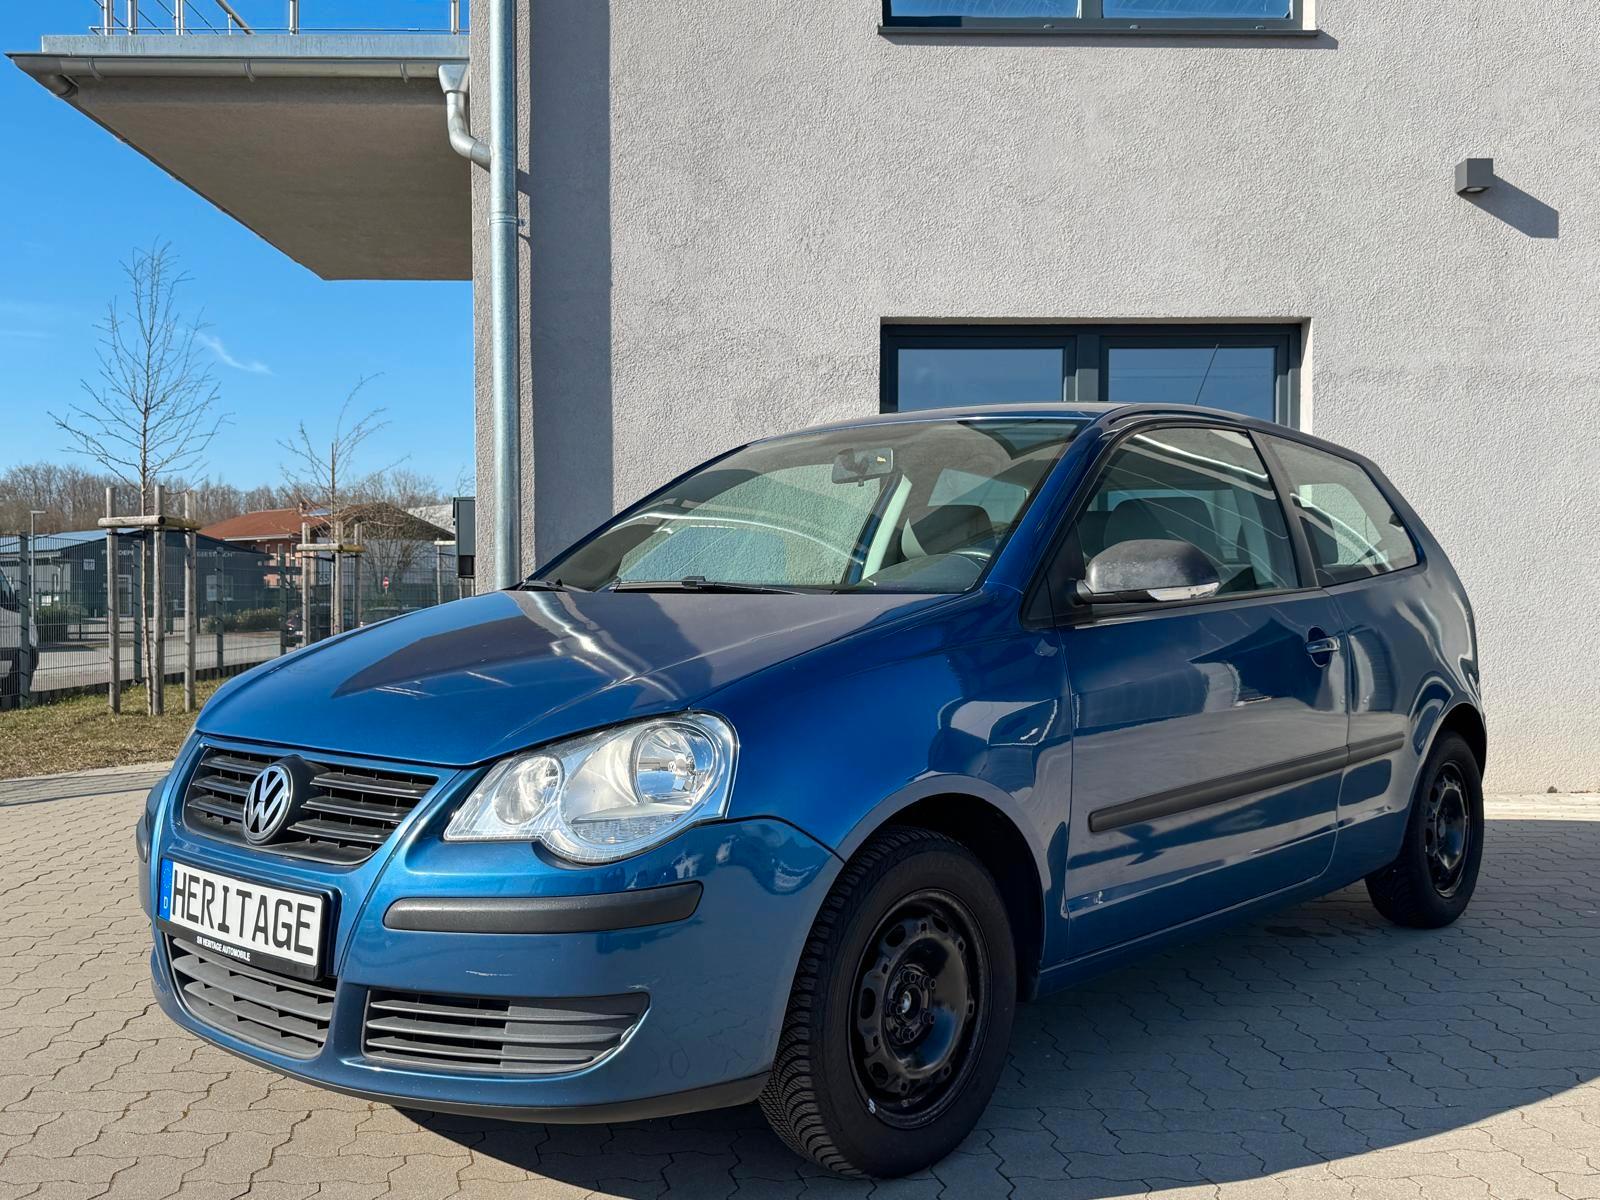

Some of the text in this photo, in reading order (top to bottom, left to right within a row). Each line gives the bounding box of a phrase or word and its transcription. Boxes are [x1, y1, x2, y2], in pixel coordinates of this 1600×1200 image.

[163, 896, 169, 909] D
[172, 869, 316, 957] HERITAGE
[203, 937, 222, 952] HERITAGE
[221, 944, 250, 962] AUTOMOBILE
